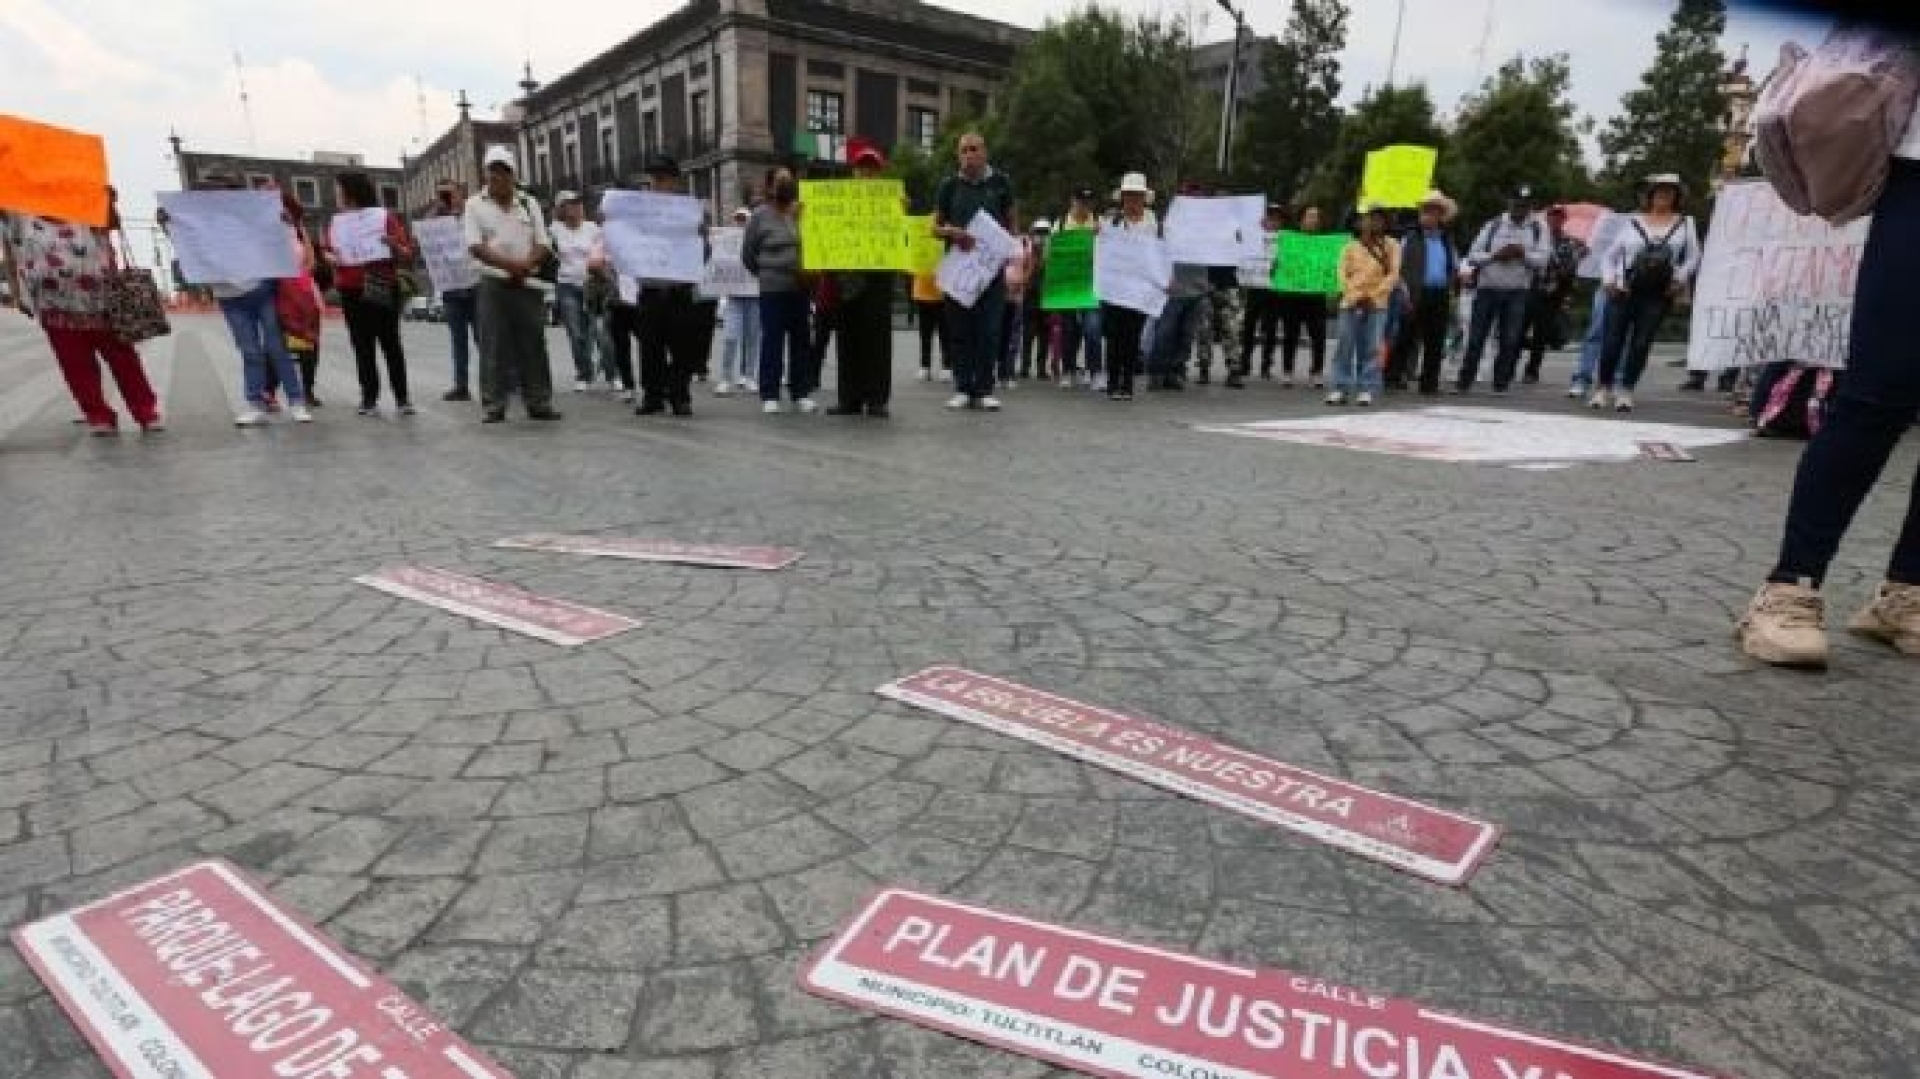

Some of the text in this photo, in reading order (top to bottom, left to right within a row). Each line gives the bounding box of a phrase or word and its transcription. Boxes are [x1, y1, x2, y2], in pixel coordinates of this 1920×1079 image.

[1109, 730, 1164, 754] ES
[1163, 744, 1354, 818] NUESTRA
[201, 962, 334, 1053] LAGO
[272, 1027, 383, 1079] DE
[883, 915, 1470, 1079] PLAN DE JUSTICIA
[981, 1006, 1104, 1055] TULTITLAN
[1289, 977, 1386, 1010] CALLE
